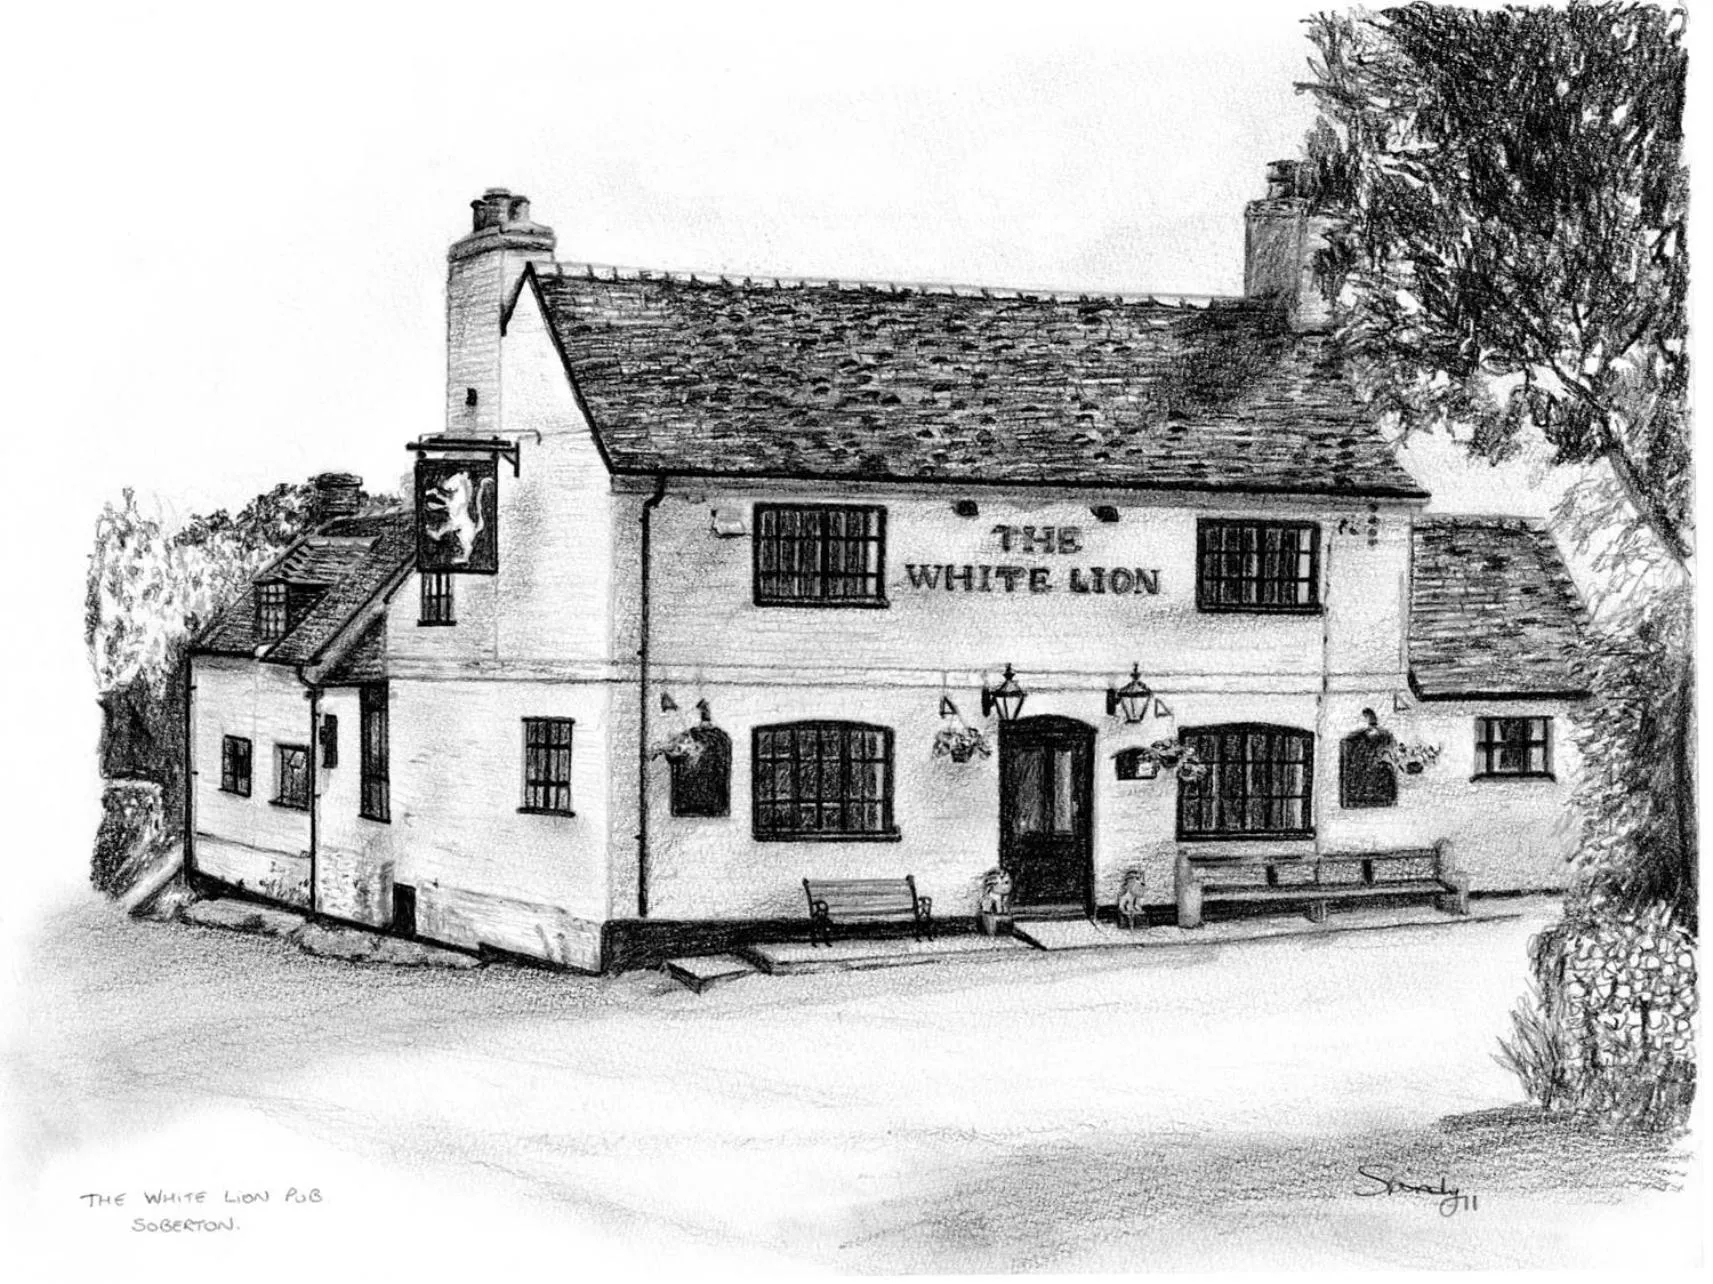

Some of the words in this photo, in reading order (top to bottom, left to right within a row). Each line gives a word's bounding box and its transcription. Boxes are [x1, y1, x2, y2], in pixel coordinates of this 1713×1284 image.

[991, 524, 1082, 554] THE
[905, 564, 1053, 593] WHITE
[1069, 566, 1162, 595] LION
[80, 1192, 127, 1208] THE
[144, 1189, 208, 1205] WHITE
[225, 1190, 269, 1205] LION
[285, 1187, 323, 1204] PUB
[131, 1217, 241, 1233] SOBERTON.
